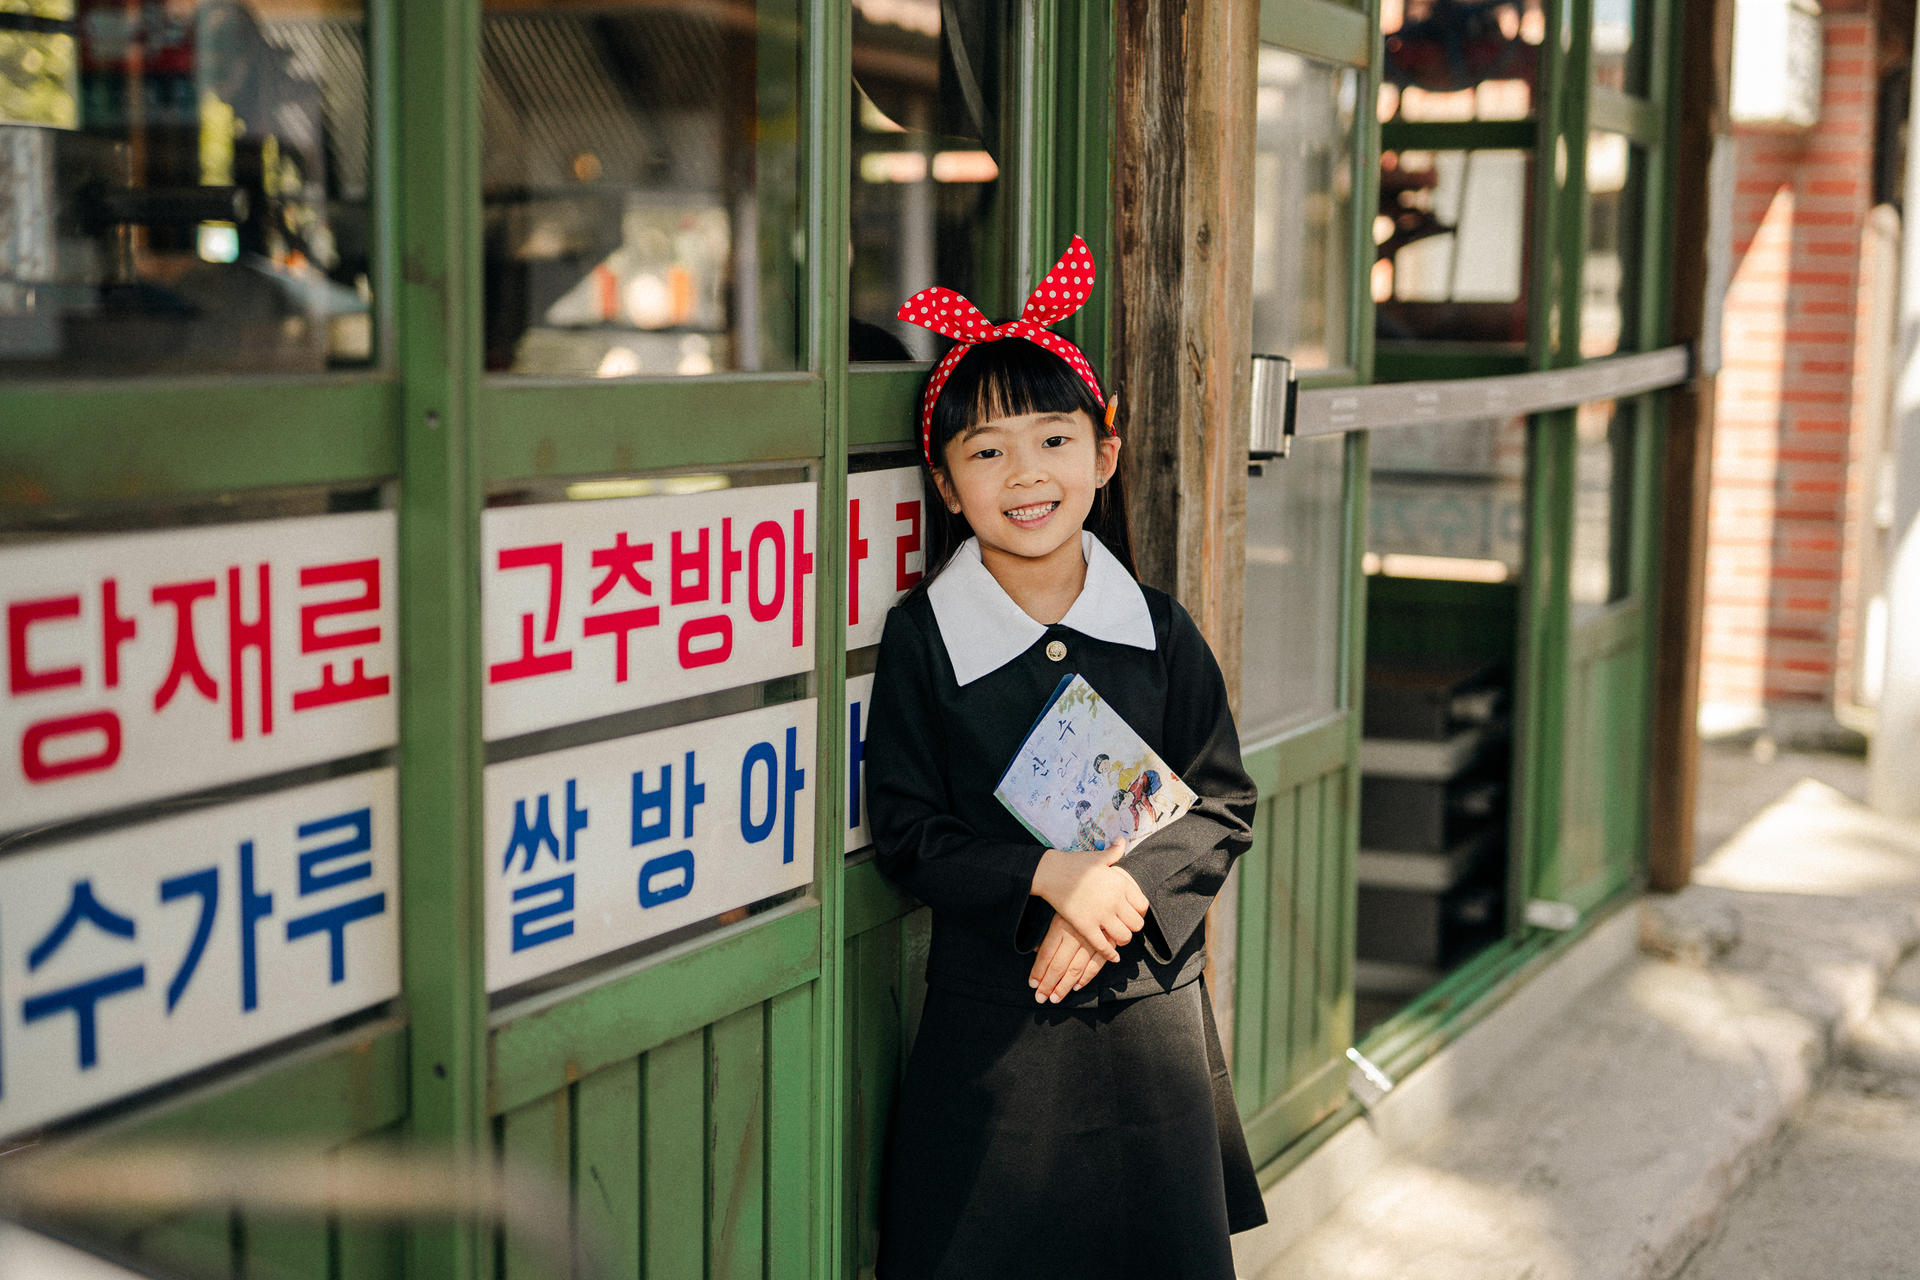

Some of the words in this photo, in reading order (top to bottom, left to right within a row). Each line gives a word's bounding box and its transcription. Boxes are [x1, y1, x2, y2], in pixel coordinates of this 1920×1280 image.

[7, 557, 391, 784] 당재료
[488, 509, 813, 685] 고추방아
[0, 808, 386, 1101] 수가루
